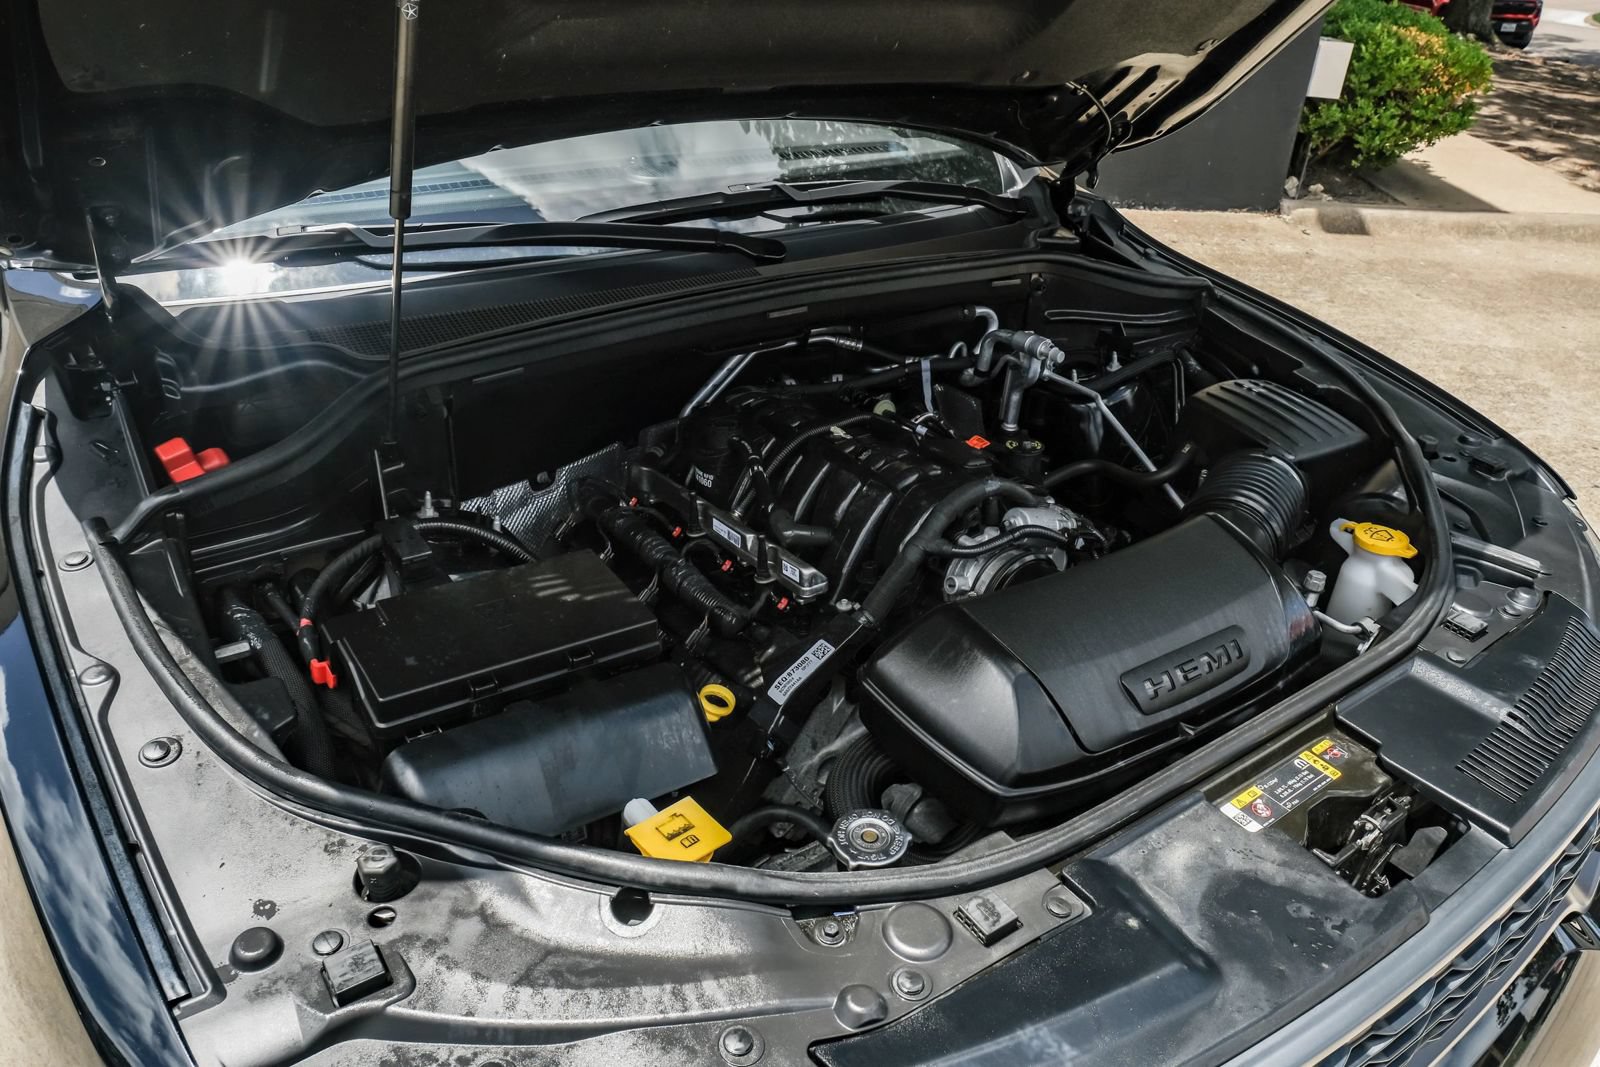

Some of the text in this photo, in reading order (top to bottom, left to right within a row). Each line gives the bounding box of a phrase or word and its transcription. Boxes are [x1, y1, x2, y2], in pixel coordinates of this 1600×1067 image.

[1142, 638, 1244, 701] HEMI
[839, 813, 858, 829] OPEN
[882, 815, 895, 825] DO
[889, 835, 903, 854] KEEP
